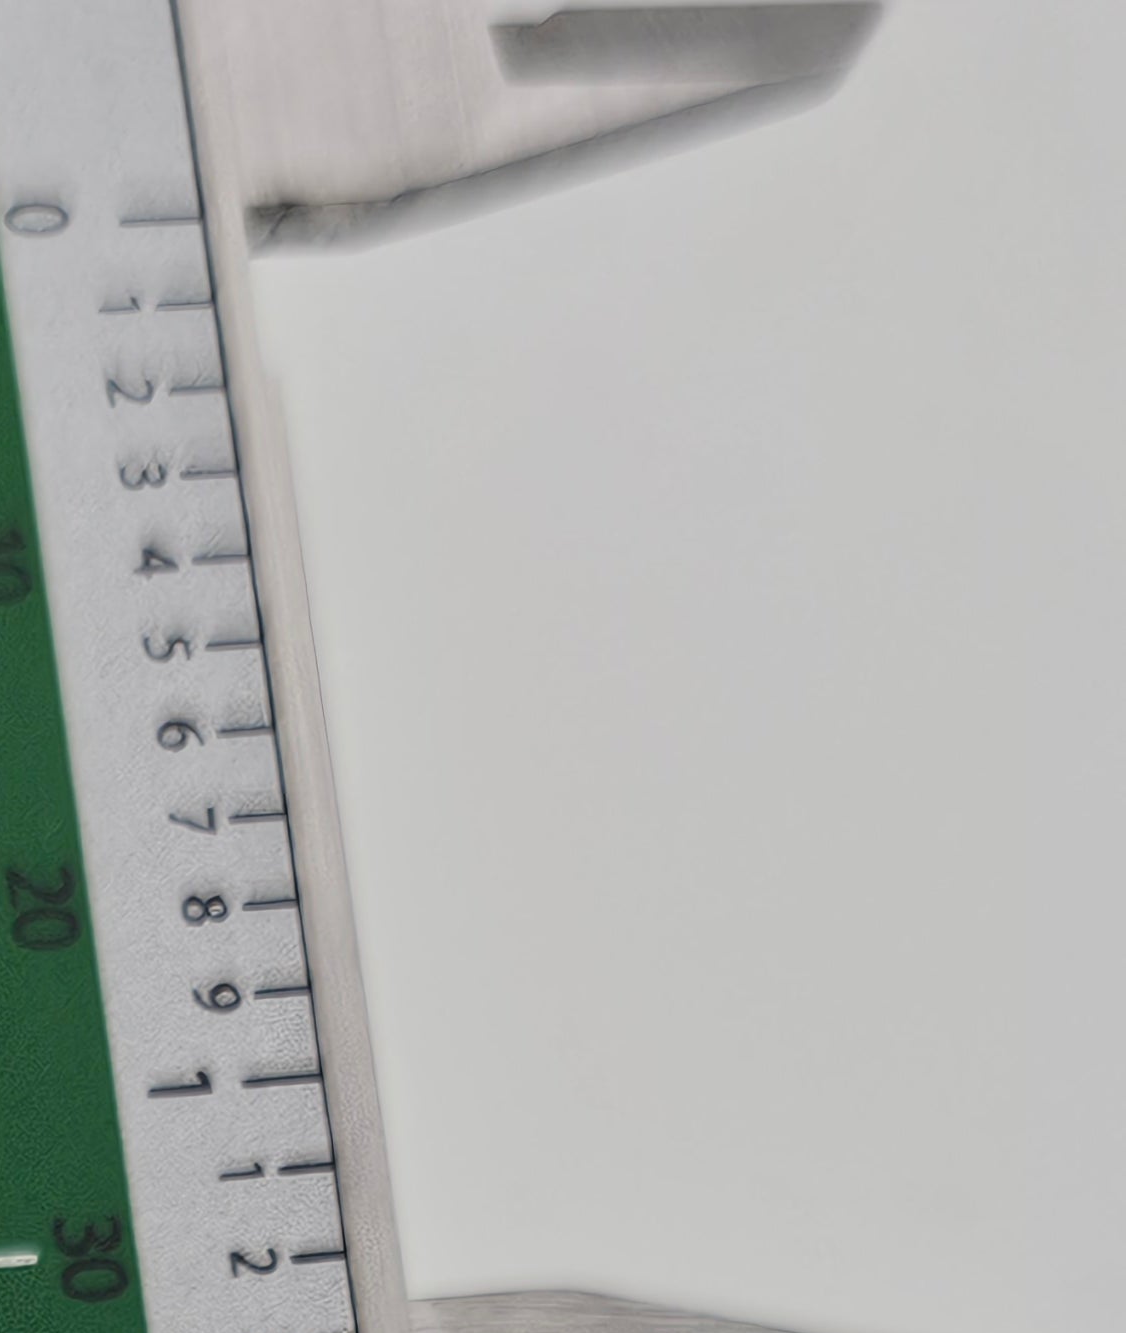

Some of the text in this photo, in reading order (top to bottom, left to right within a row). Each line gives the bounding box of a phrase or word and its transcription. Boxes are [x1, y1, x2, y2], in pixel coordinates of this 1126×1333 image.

[105, 378, 156, 408] 2
[119, 460, 166, 491] 3
[134, 547, 179, 578] 4
[142, 634, 193, 662] 5
[156, 720, 205, 752] 6
[168, 806, 216, 835] 7
[5, 862, 81, 950] 20
[181, 894, 229, 926] 8
[192, 982, 242, 1014] 9
[147, 1070, 212, 1099] 1
[218, 1161, 265, 1182] 1
[52, 1212, 129, 1304] 30
[229, 1246, 279, 1278] 2
